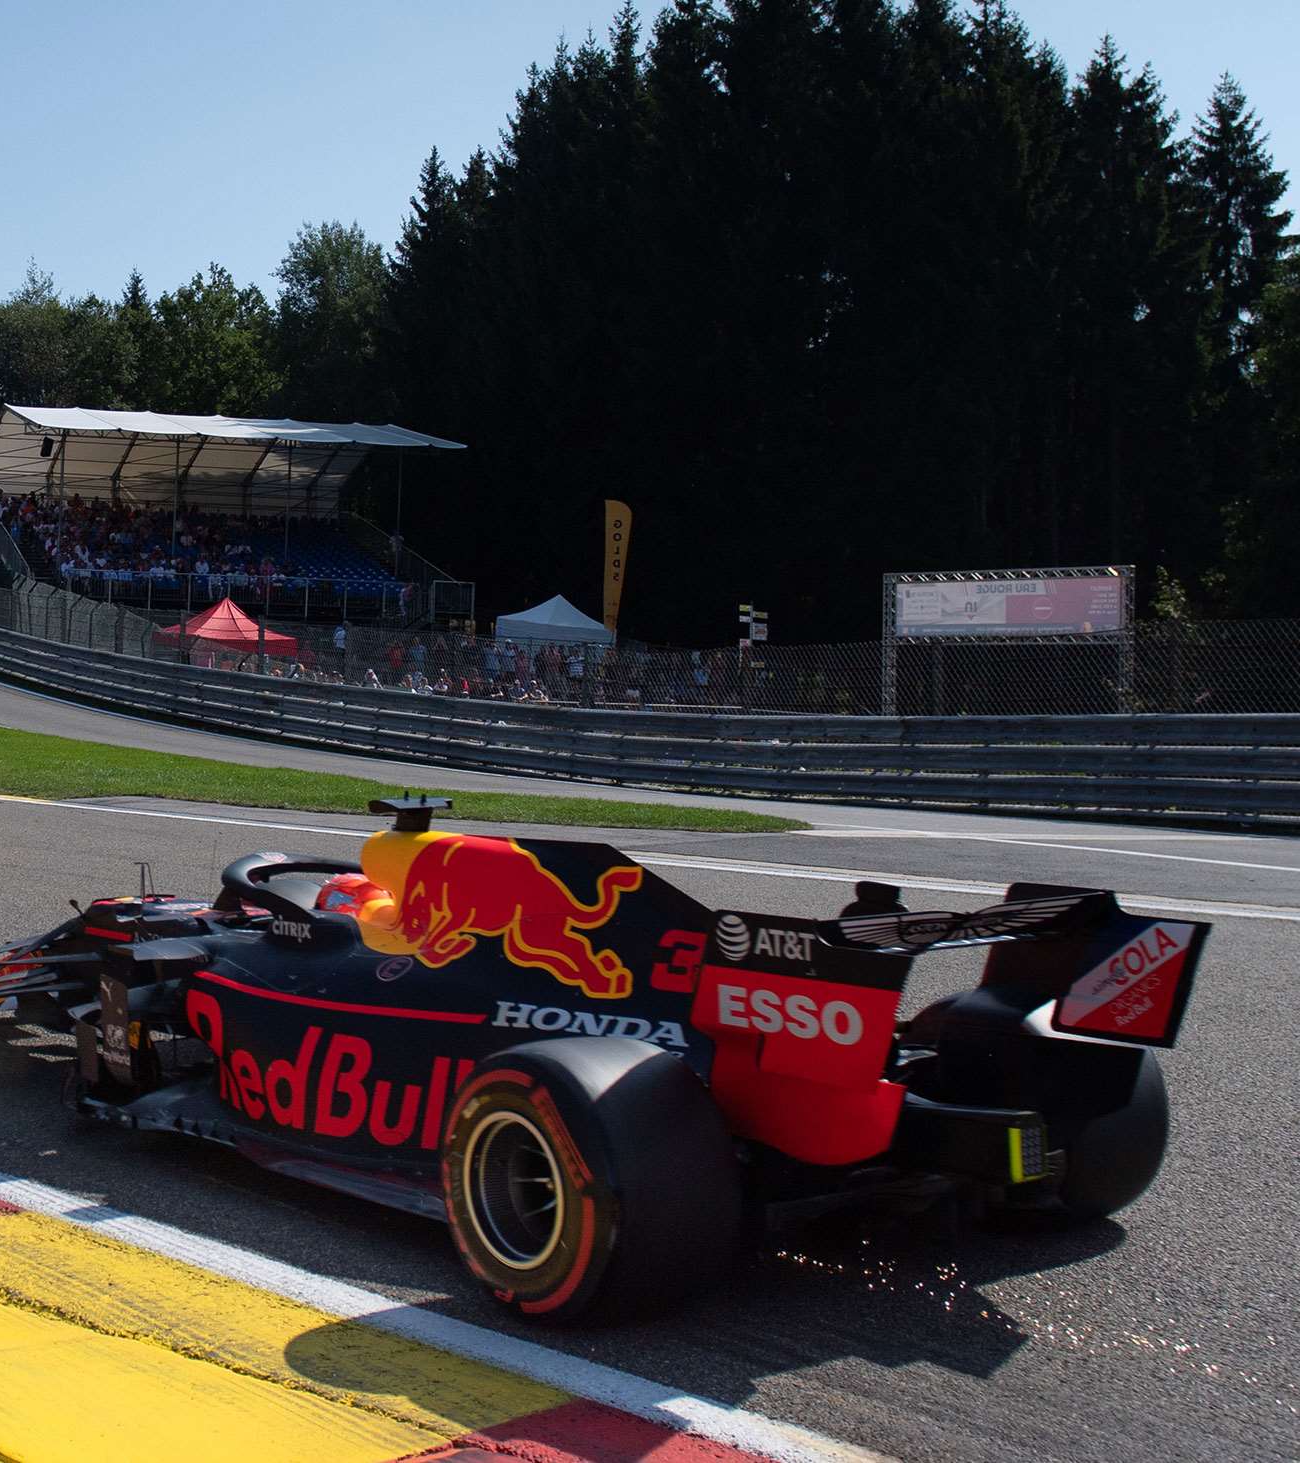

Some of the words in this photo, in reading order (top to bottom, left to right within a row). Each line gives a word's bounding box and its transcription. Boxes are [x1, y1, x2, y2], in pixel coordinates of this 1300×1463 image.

[755, 928, 815, 962] AT&T
[1108, 927, 1179, 986] COLA
[491, 1000, 690, 1048] HONDA
[717, 984, 864, 1046] ESSO
